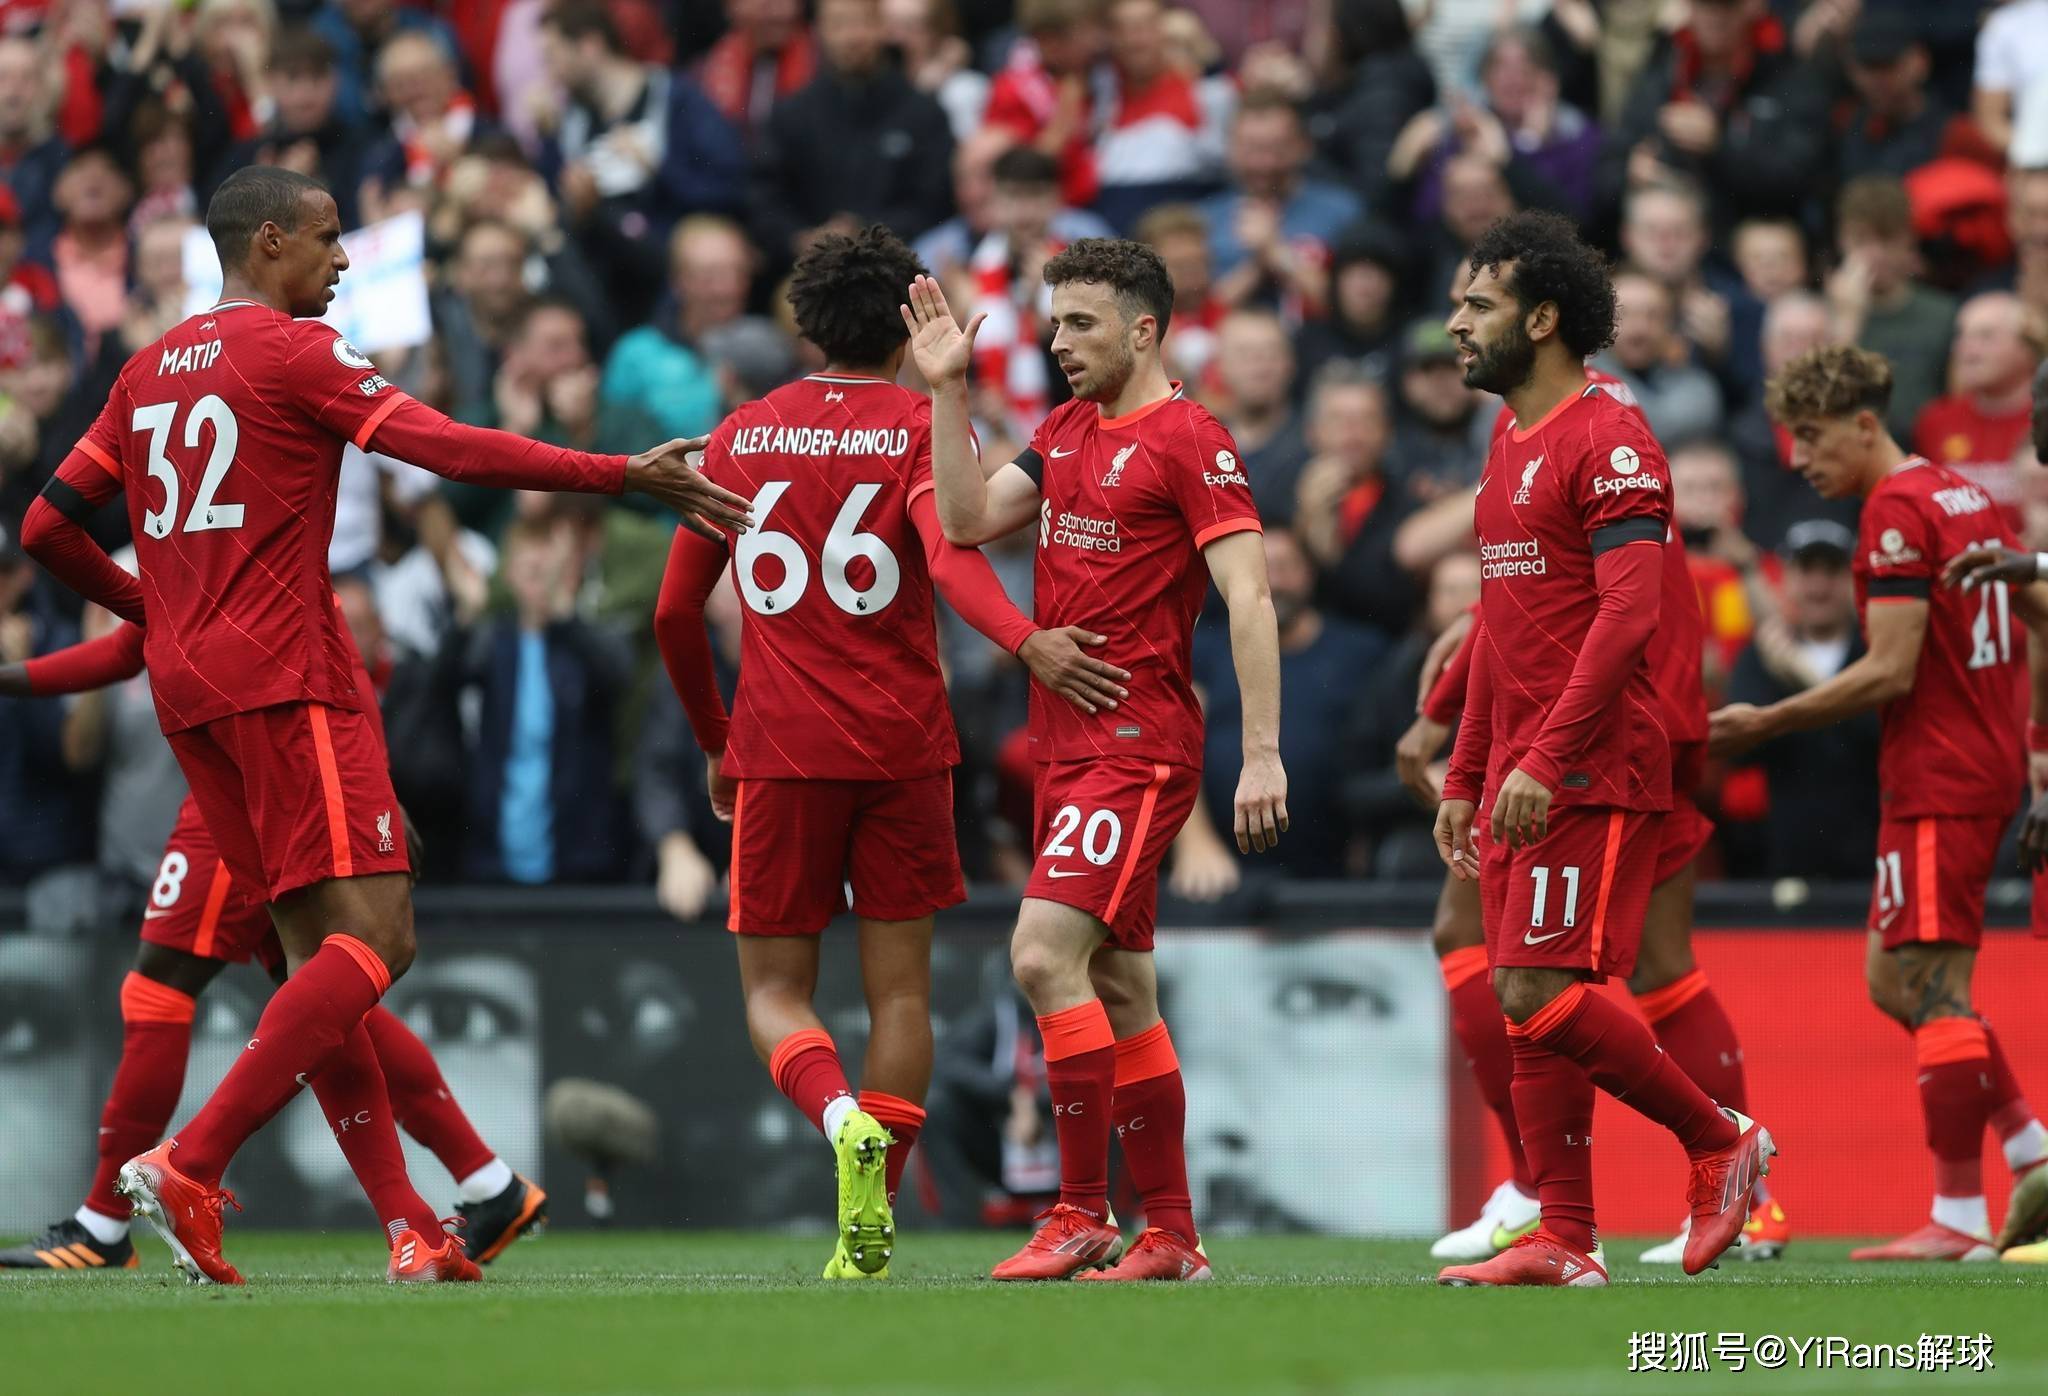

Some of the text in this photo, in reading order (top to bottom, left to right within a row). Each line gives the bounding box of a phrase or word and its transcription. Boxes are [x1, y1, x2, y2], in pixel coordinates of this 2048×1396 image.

[158, 339, 222, 376] MATIP
[730, 426, 908, 456] ALEXANDER-ARNOLD
[132, 394, 245, 539] 32
[1593, 472, 1661, 495] Expedia
[1057, 511, 1116, 536] standard
[735, 481, 900, 616] 66
[1053, 529, 1120, 552] chartered
[1481, 538, 1538, 560] standard
[1482, 557, 1546, 579] chartered
[1042, 805, 1122, 865] 20
[152, 851, 188, 908] 8
[1531, 866, 1580, 928] 11
[1052, 1102, 1083, 1116] FC
